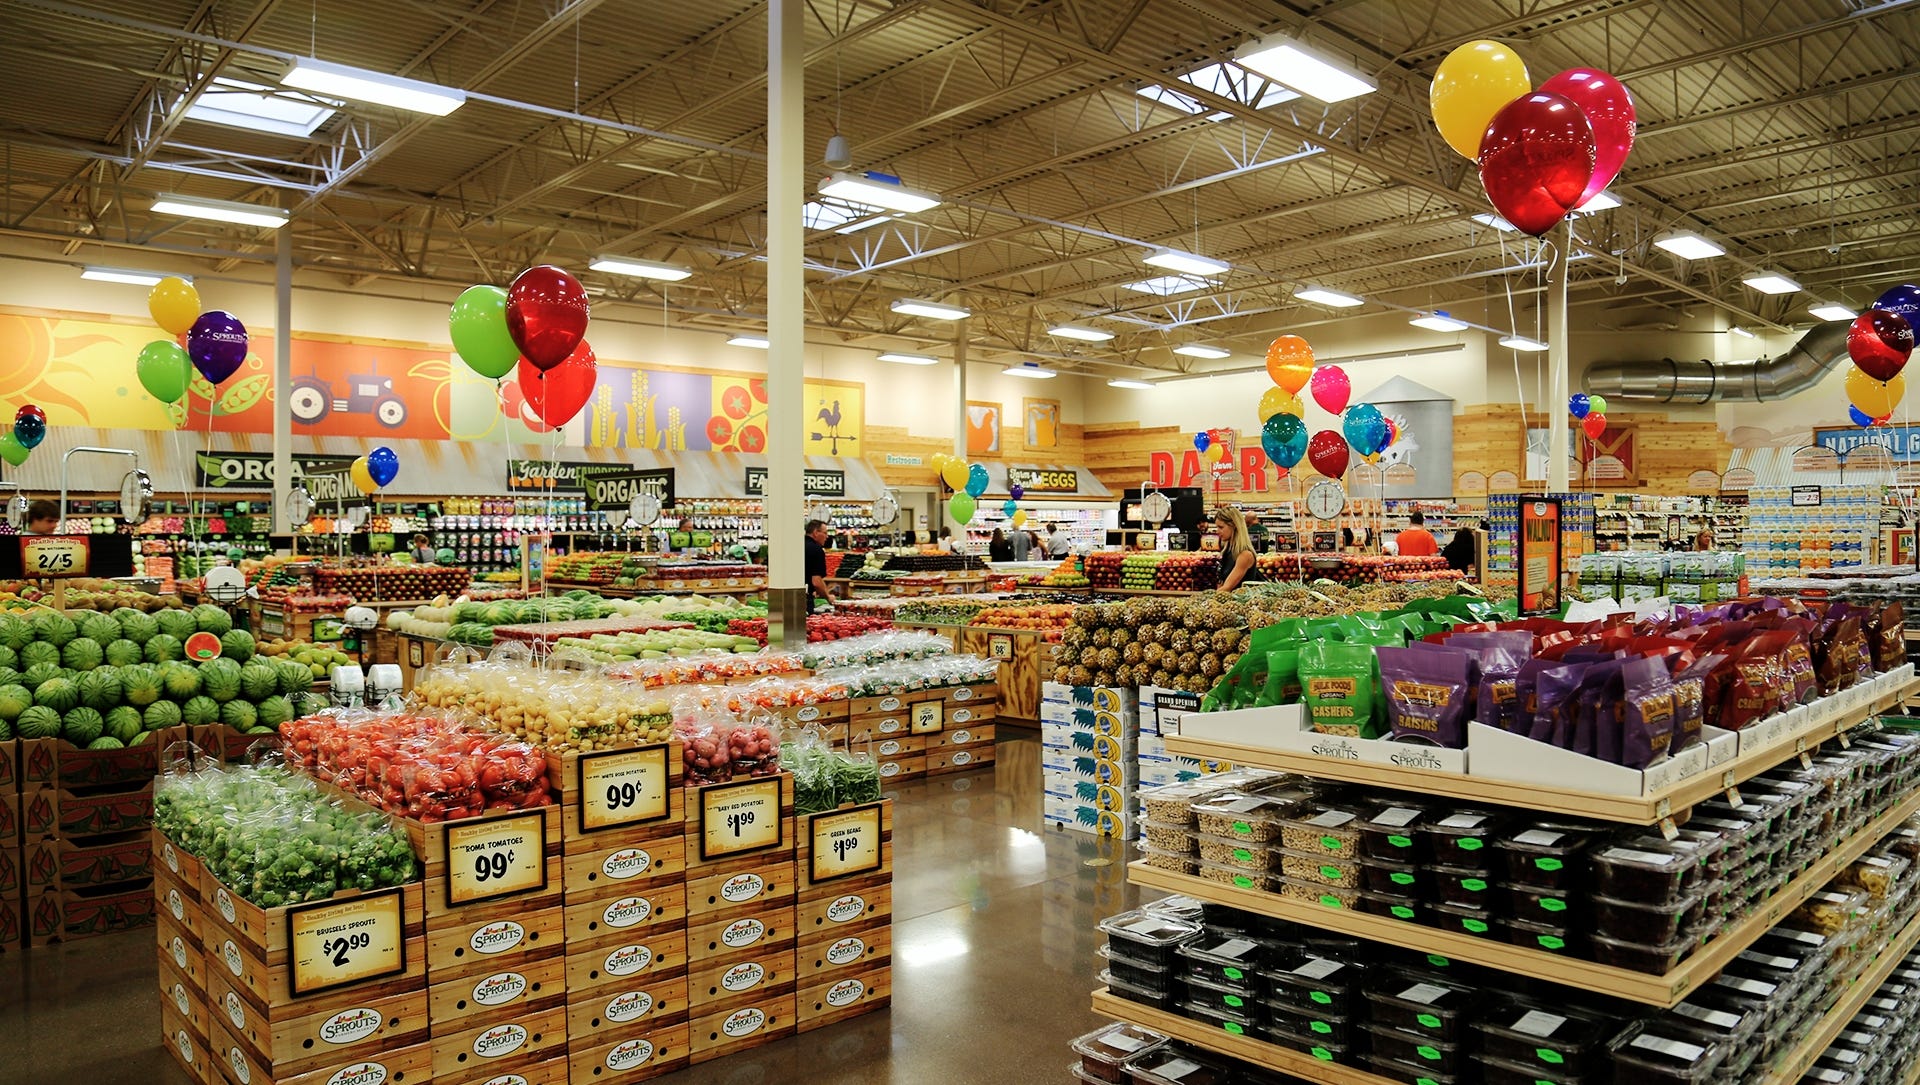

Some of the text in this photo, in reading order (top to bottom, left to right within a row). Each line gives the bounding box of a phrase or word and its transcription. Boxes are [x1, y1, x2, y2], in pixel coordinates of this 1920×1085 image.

[887, 454, 921, 464] Restrooms
[1314, 446, 1337, 459] SPROUTS
[519, 461, 577, 480] Garden
[1041, 472, 1076, 488] EGGS
[1330, 680, 1352, 690] FOODS
[1175, 698, 1197, 707] OPENING
[1312, 706, 1354, 718] CASHEWS
[1399, 715, 1439, 732] RAISINS
[1311, 745, 1359, 760] SPROUTS
[1390, 754, 1442, 769] SPROUTS
[606, 780, 642, 810] 99¢
[830, 826, 862, 838] GREEN BEANS
[465, 837, 524, 853] ROMA TOMATOES
[475, 849, 515, 882] 99¢
[606, 856, 648, 874] SPROUTS
[724, 881, 761, 898] SPROUTS
[607, 904, 648, 923] SPROUTS
[830, 902, 863, 918] SPROUTS
[316, 925, 346, 936] BRUSSELS
[348, 918, 376, 930] SPROUTS
[725, 926, 762, 943] SPROUTS
[475, 928, 521, 949] SPROUTS
[829, 944, 862, 961] SPROUTS
[608, 952, 649, 971] SPROUTS
[725, 970, 762, 987] SPROUTS
[477, 980, 523, 1001] SPROUTS
[829, 986, 862, 1003] SPROUTS
[609, 998, 650, 1018] SPROUTS
[325, 1015, 378, 1039] SPROUTS
[726, 1015, 762, 1033] SPROUTS
[477, 1031, 524, 1053] SPROUTS
[610, 1046, 651, 1067] SPROUTS
